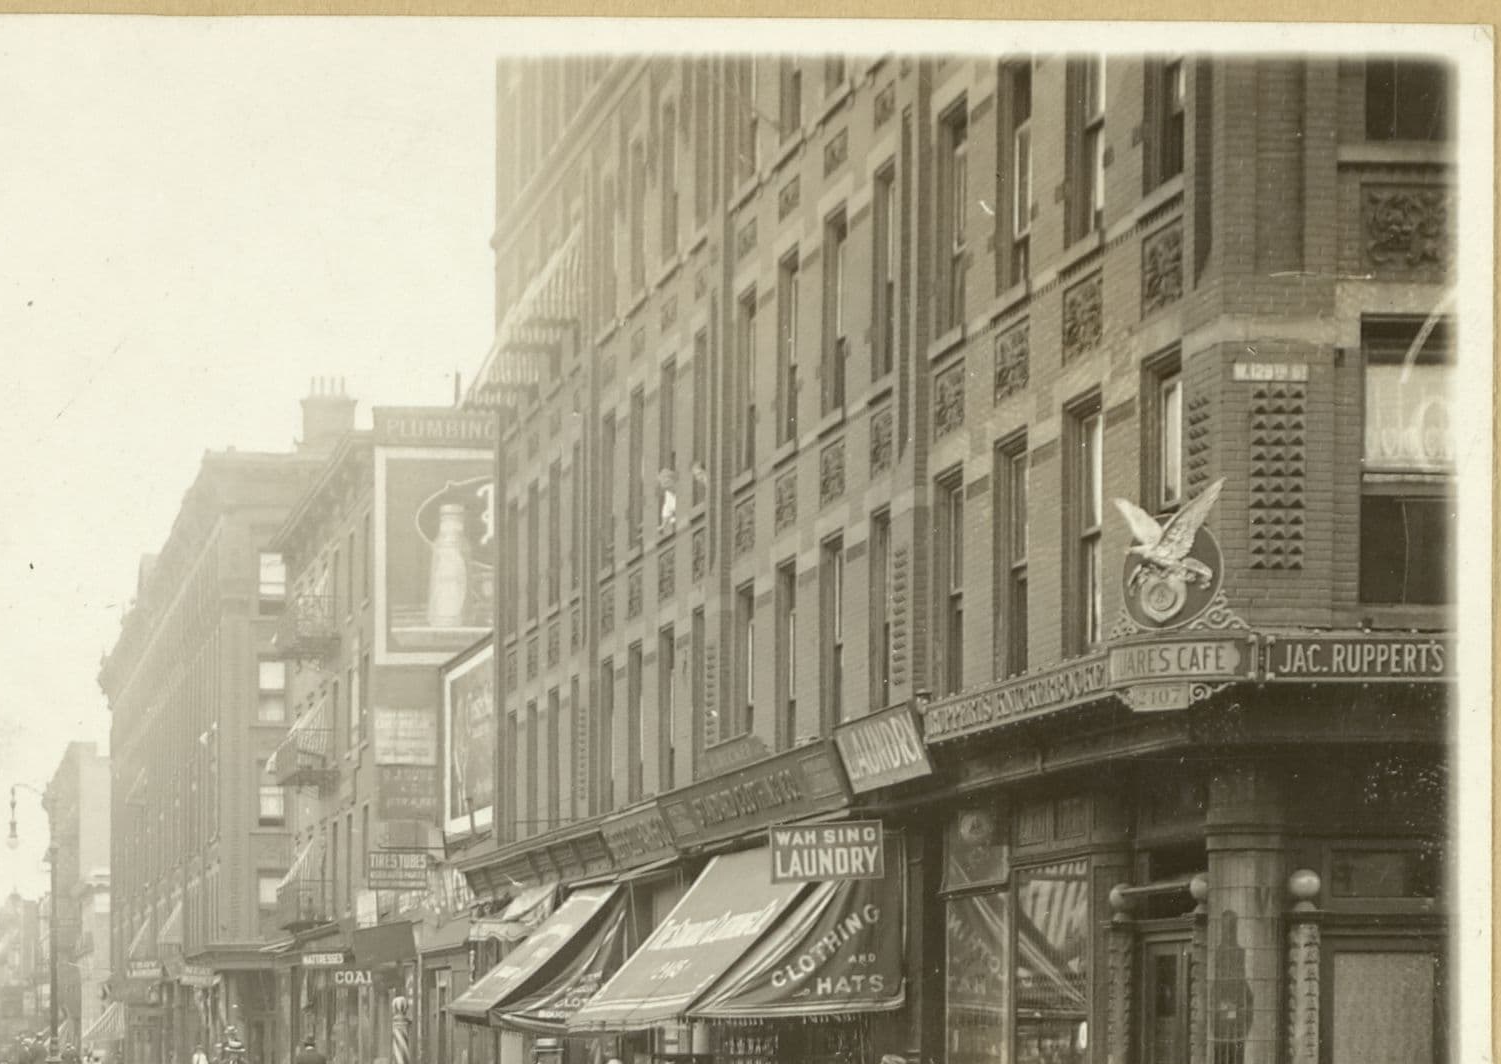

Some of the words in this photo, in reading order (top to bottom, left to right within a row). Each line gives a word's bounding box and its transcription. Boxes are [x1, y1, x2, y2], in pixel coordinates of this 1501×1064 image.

[1279, 643, 1329, 674] JAC.
[840, 709, 924, 784] LAUNDRY
[776, 830, 816, 845] WAH
[823, 827, 877, 844] SING
[775, 846, 878, 878] LAUNDRY
[771, 904, 880, 988] CLOTHING
[848, 952, 877, 963] AND
[817, 974, 885, 995] HATS
